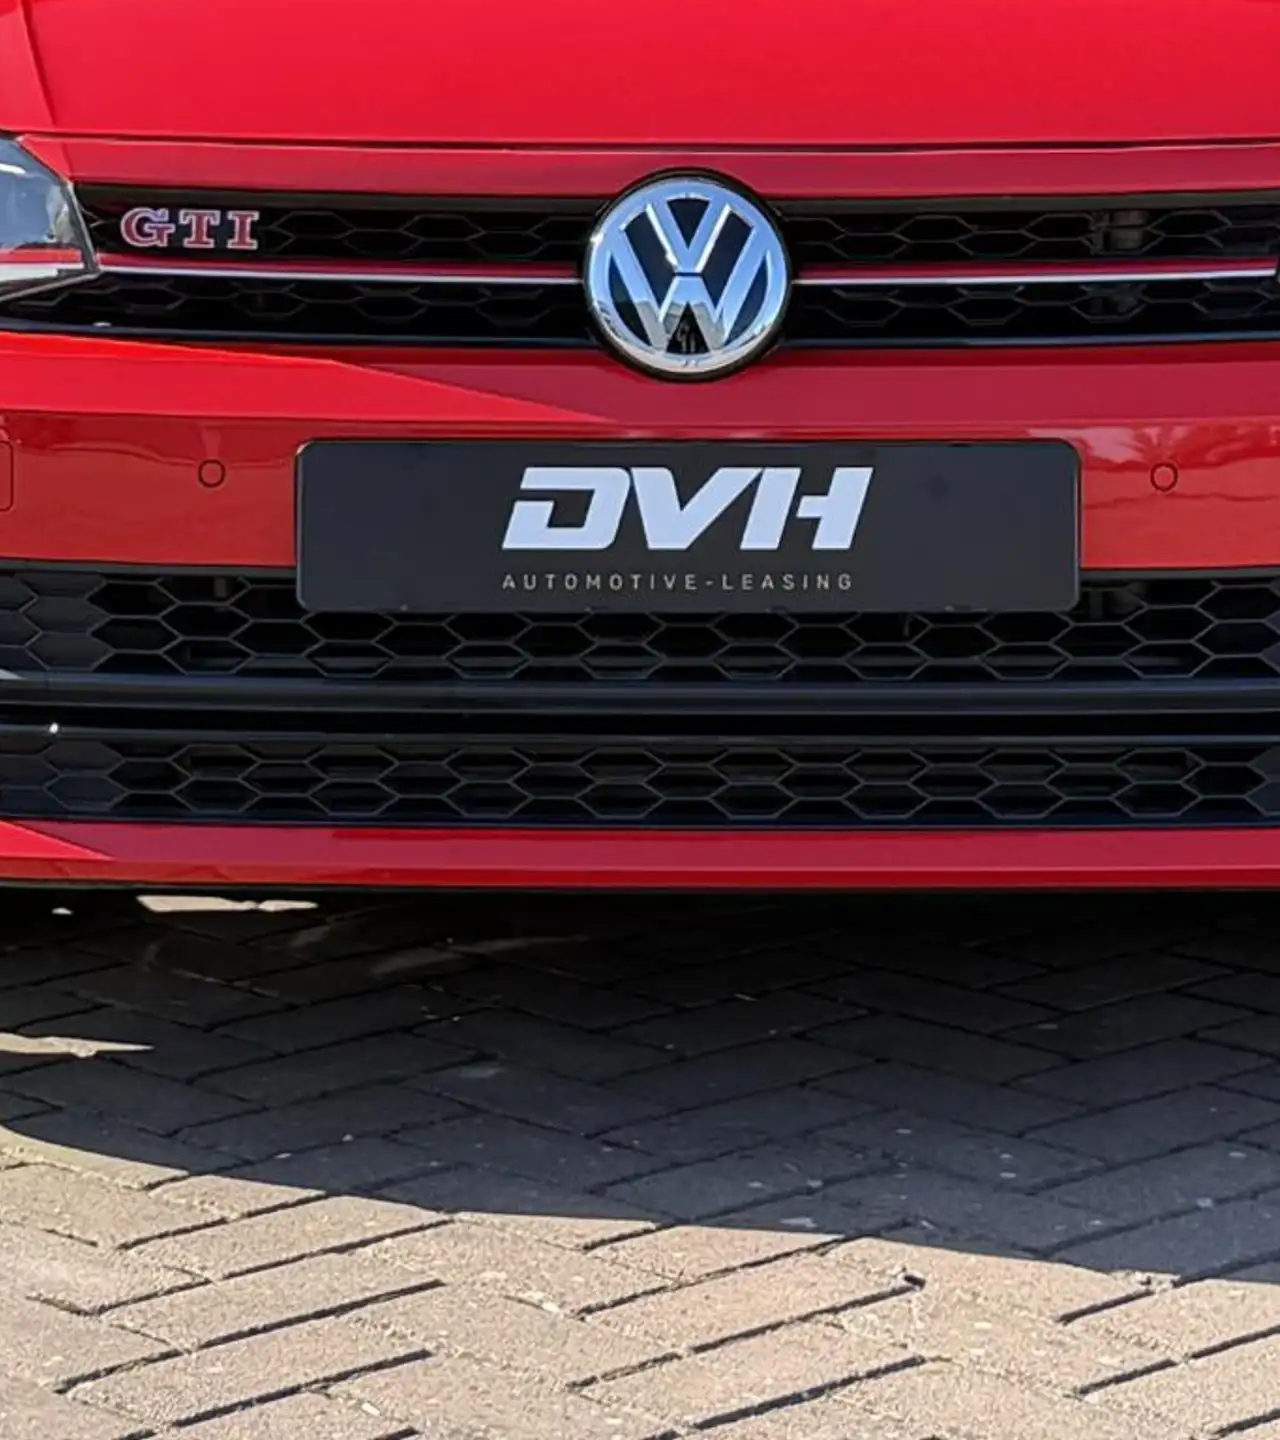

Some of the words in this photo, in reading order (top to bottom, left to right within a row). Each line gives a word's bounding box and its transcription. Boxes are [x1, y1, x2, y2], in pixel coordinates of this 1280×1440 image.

[120, 207, 260, 250] GTI
[501, 466, 874, 551] DVH
[501, 573, 853, 591] AUTOMOTIVE-LEASING
